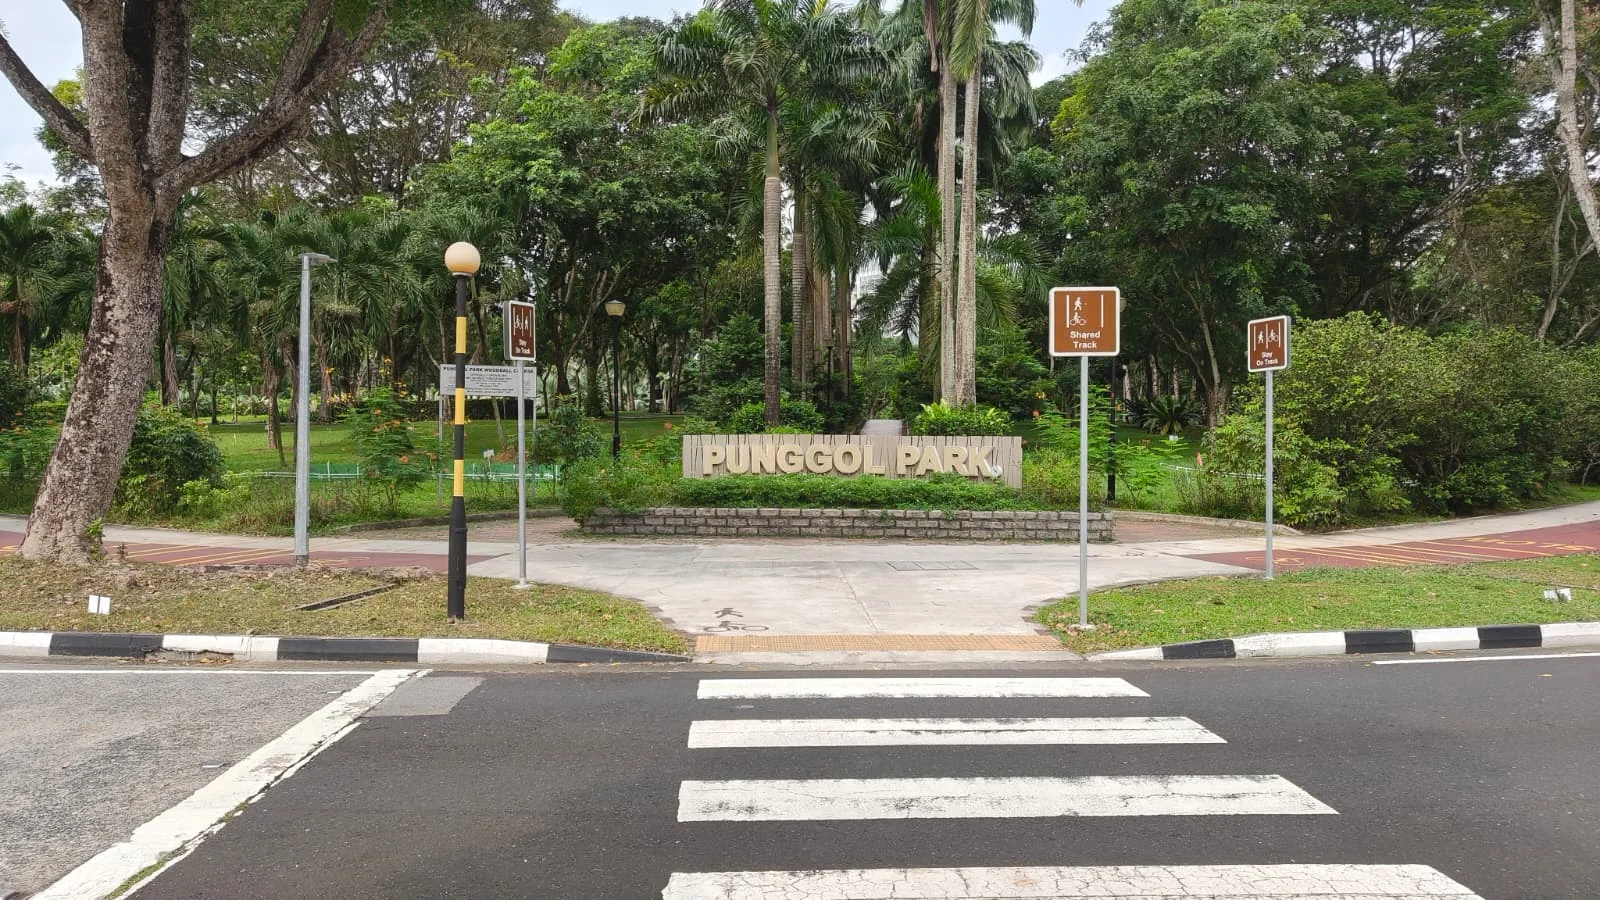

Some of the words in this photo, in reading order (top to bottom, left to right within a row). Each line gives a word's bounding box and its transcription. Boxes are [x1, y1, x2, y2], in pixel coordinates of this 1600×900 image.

[1070, 330, 1101, 340] Shared
[1072, 341, 1097, 349] Track
[702, 443, 885, 476] PUNGGOL
[896, 444, 995, 478] PARK
